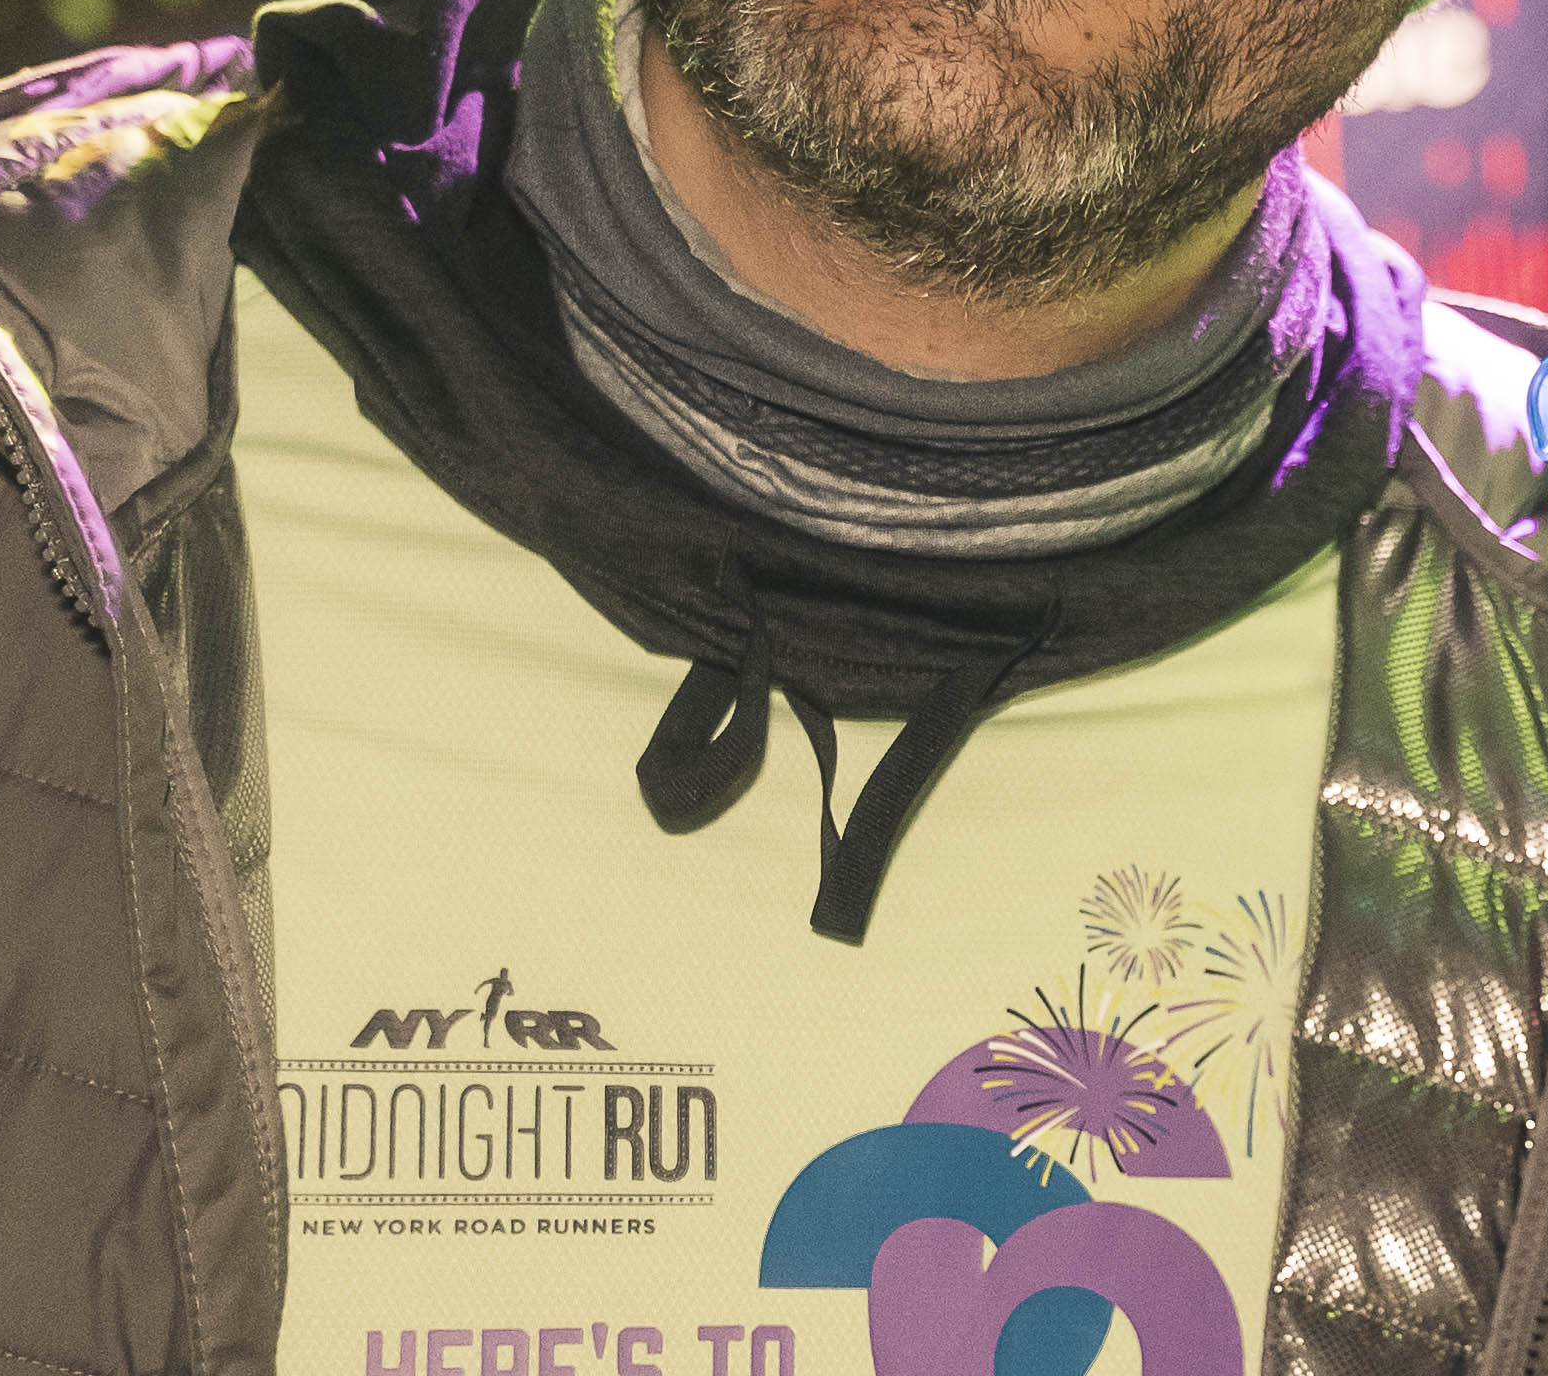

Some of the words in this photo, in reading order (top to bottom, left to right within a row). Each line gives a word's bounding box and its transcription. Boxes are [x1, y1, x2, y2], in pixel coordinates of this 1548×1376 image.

[605, 1085, 718, 1182] RUN
[303, 1218, 365, 1236] NEW
[373, 1218, 443, 1235] YORK
[454, 1218, 526, 1235] ROAD
[537, 1217, 657, 1235] RUNNERS
